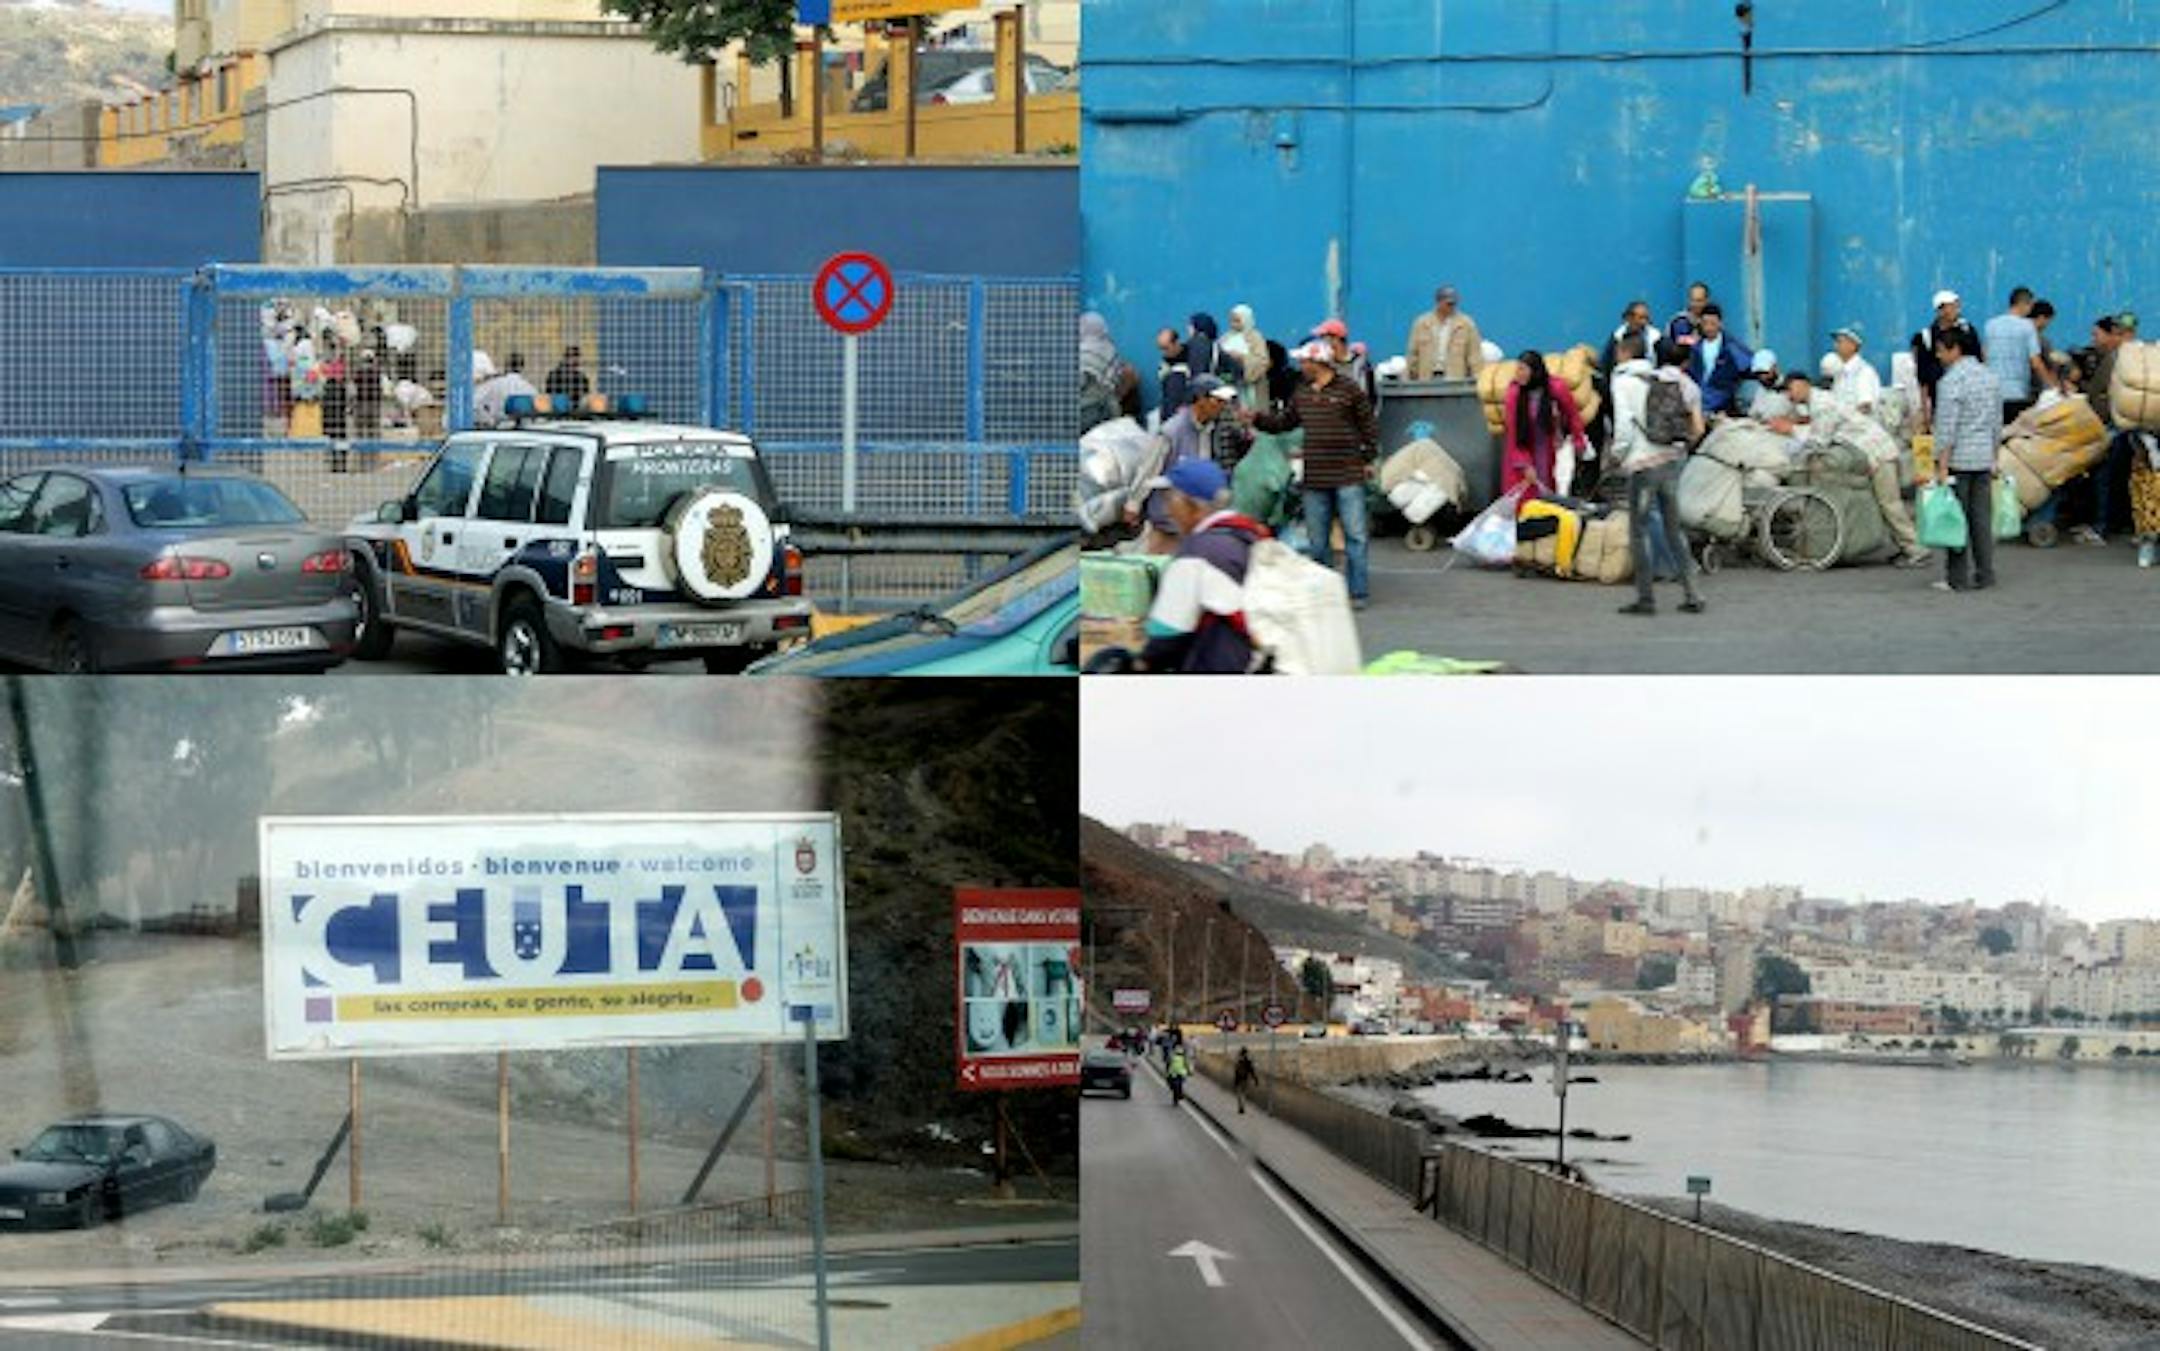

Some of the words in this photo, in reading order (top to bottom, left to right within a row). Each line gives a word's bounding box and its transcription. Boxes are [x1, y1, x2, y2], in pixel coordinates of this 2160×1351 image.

[295, 856, 465, 879] bienvenidos
[484, 857, 621, 874] bienvenue
[640, 855, 755, 873] welcome
[293, 884, 756, 986] CEUTA
[505, 998, 529, 1008] su
